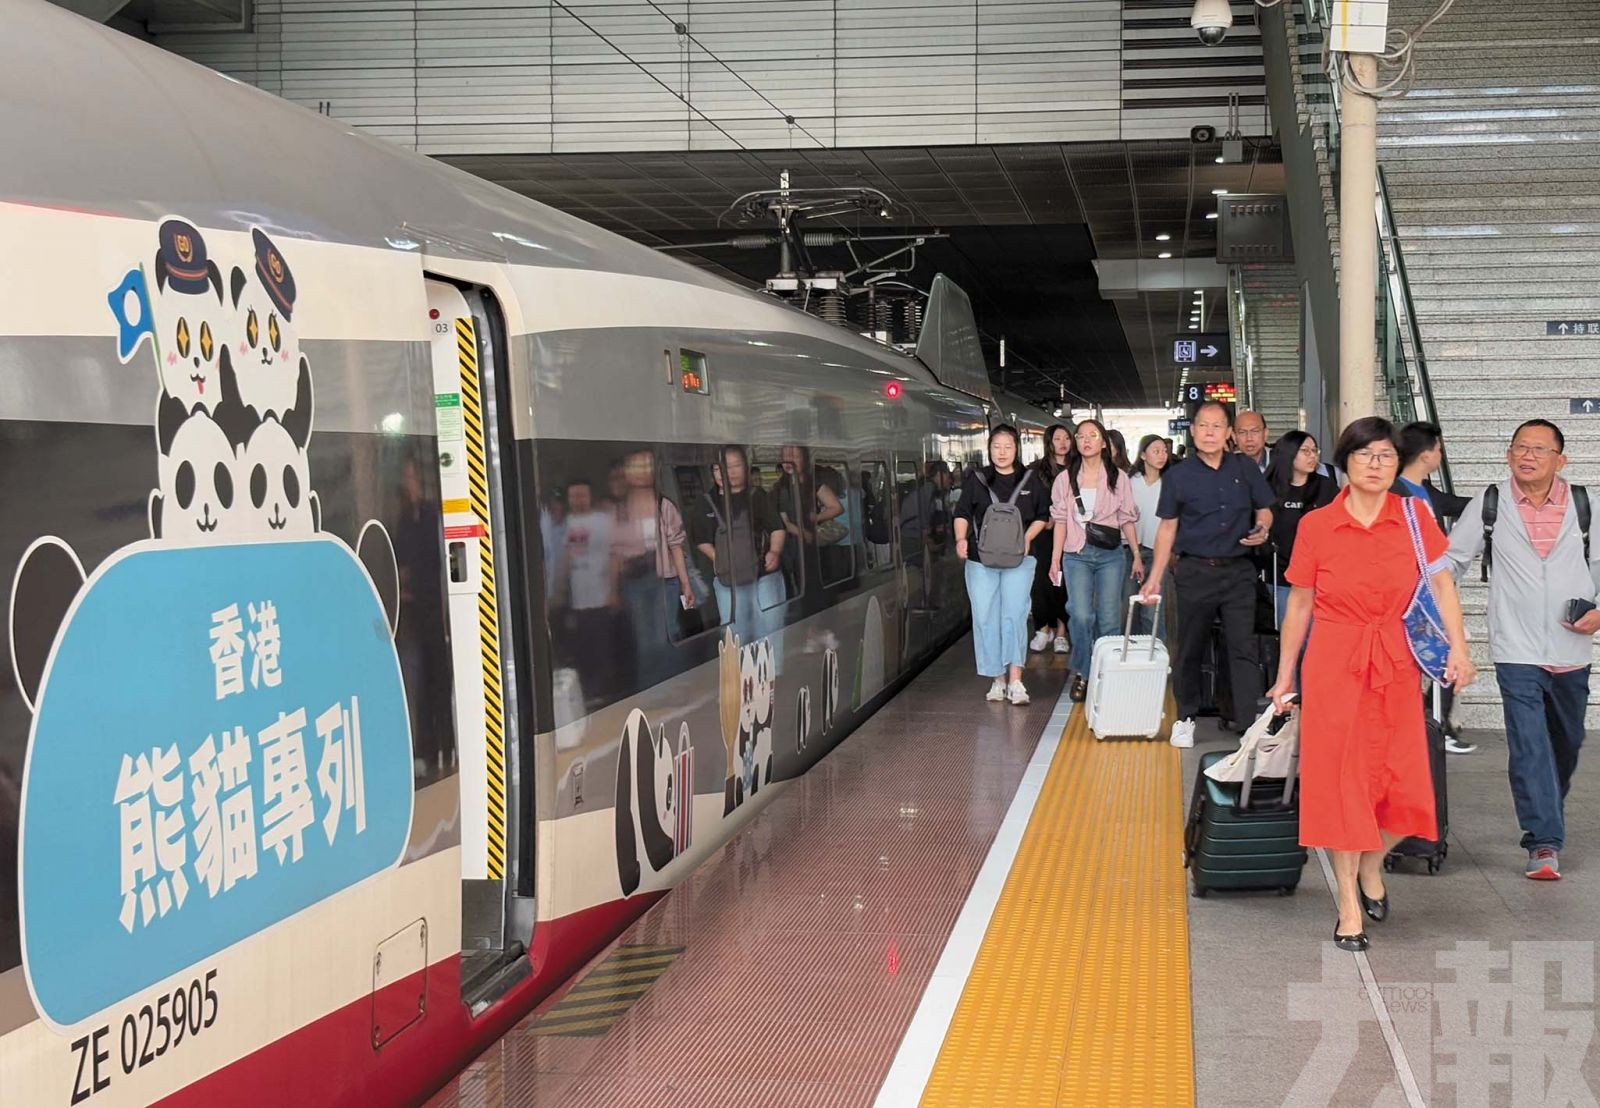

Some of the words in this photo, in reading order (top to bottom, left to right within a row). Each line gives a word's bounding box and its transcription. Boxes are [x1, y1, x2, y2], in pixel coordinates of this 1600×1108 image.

[435, 323, 449, 333] 03
[1189, 386, 1199, 400] 8
[209, 599, 283, 701] 香港
[113, 695, 366, 936] 熊貓專列
[70, 1024, 112, 1107] ZE
[120, 968, 218, 1074] 025905
